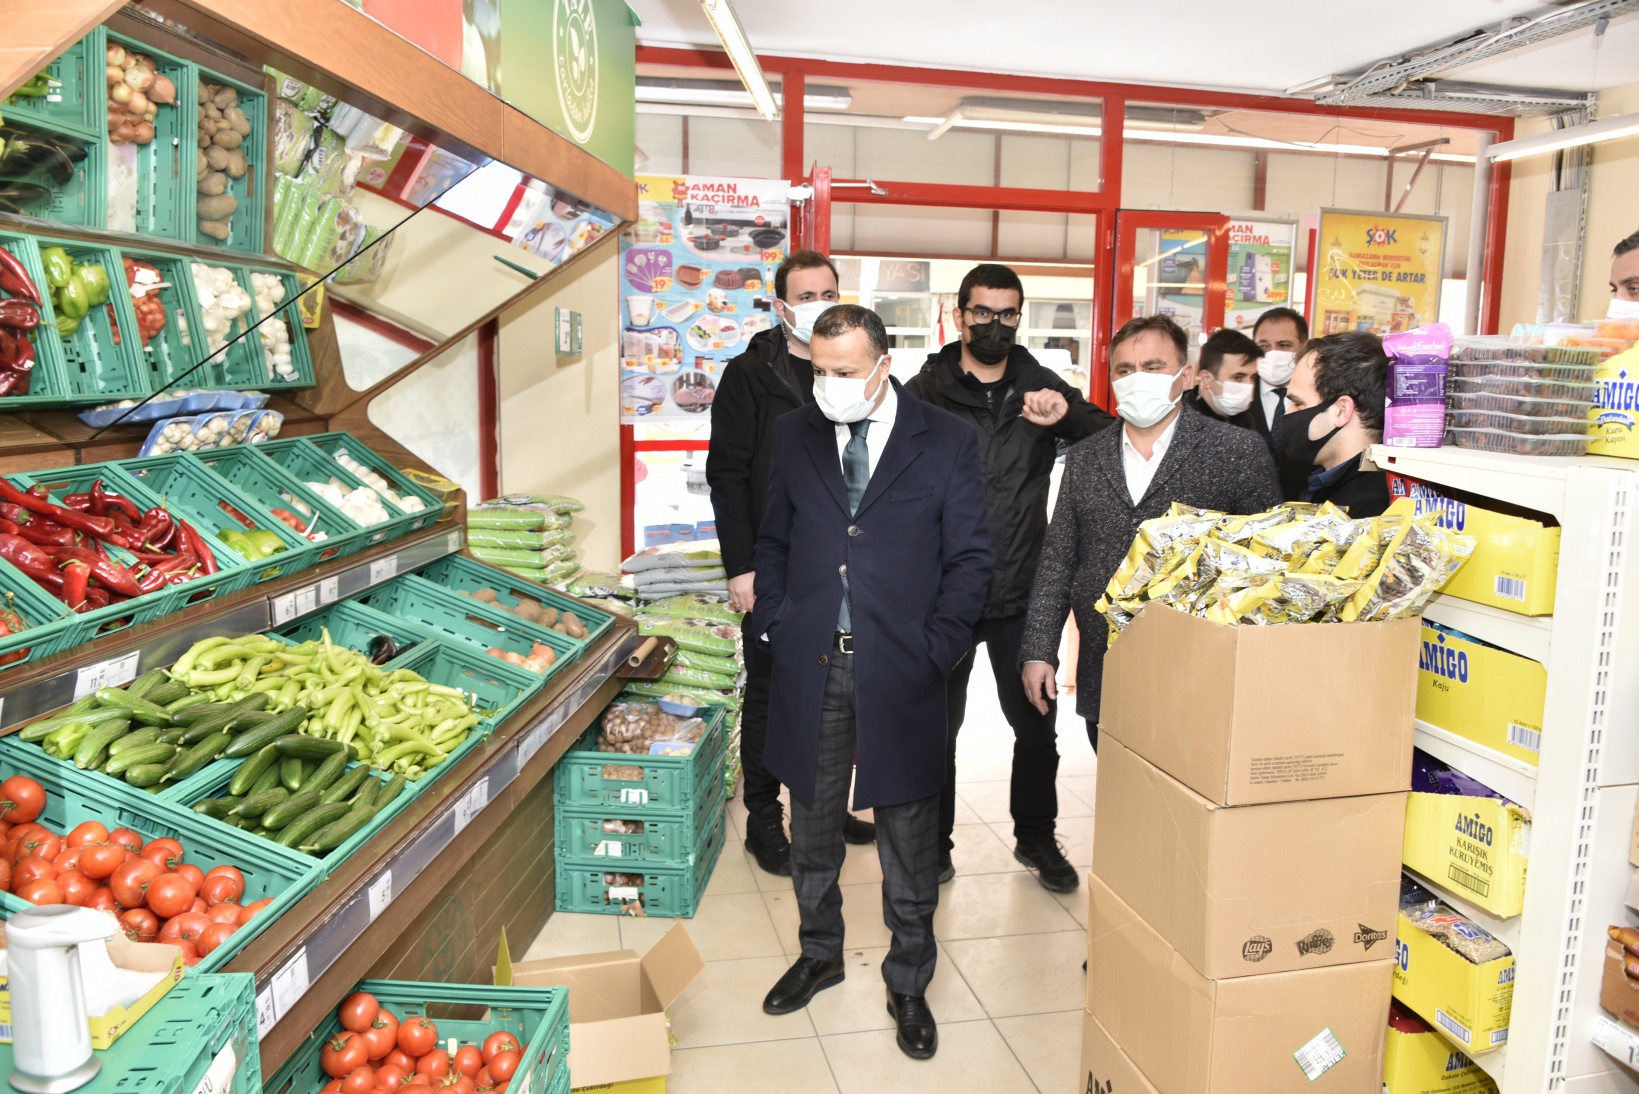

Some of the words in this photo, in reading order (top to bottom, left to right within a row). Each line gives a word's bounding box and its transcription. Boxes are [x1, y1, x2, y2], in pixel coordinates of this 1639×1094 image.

[690, 183, 738, 194] AMAN
[690, 193, 761, 208] KAÇIRMA
[1366, 227, 1398, 248] ŞOK
[759, 251, 778, 262] 199
[1381, 271, 1394, 282] DE
[1395, 272, 1427, 284] ARTAR
[1432, 679, 1450, 692] Kaju
[1456, 837, 1488, 861] KARIŞIK
[1354, 931, 1388, 943] Doritos
